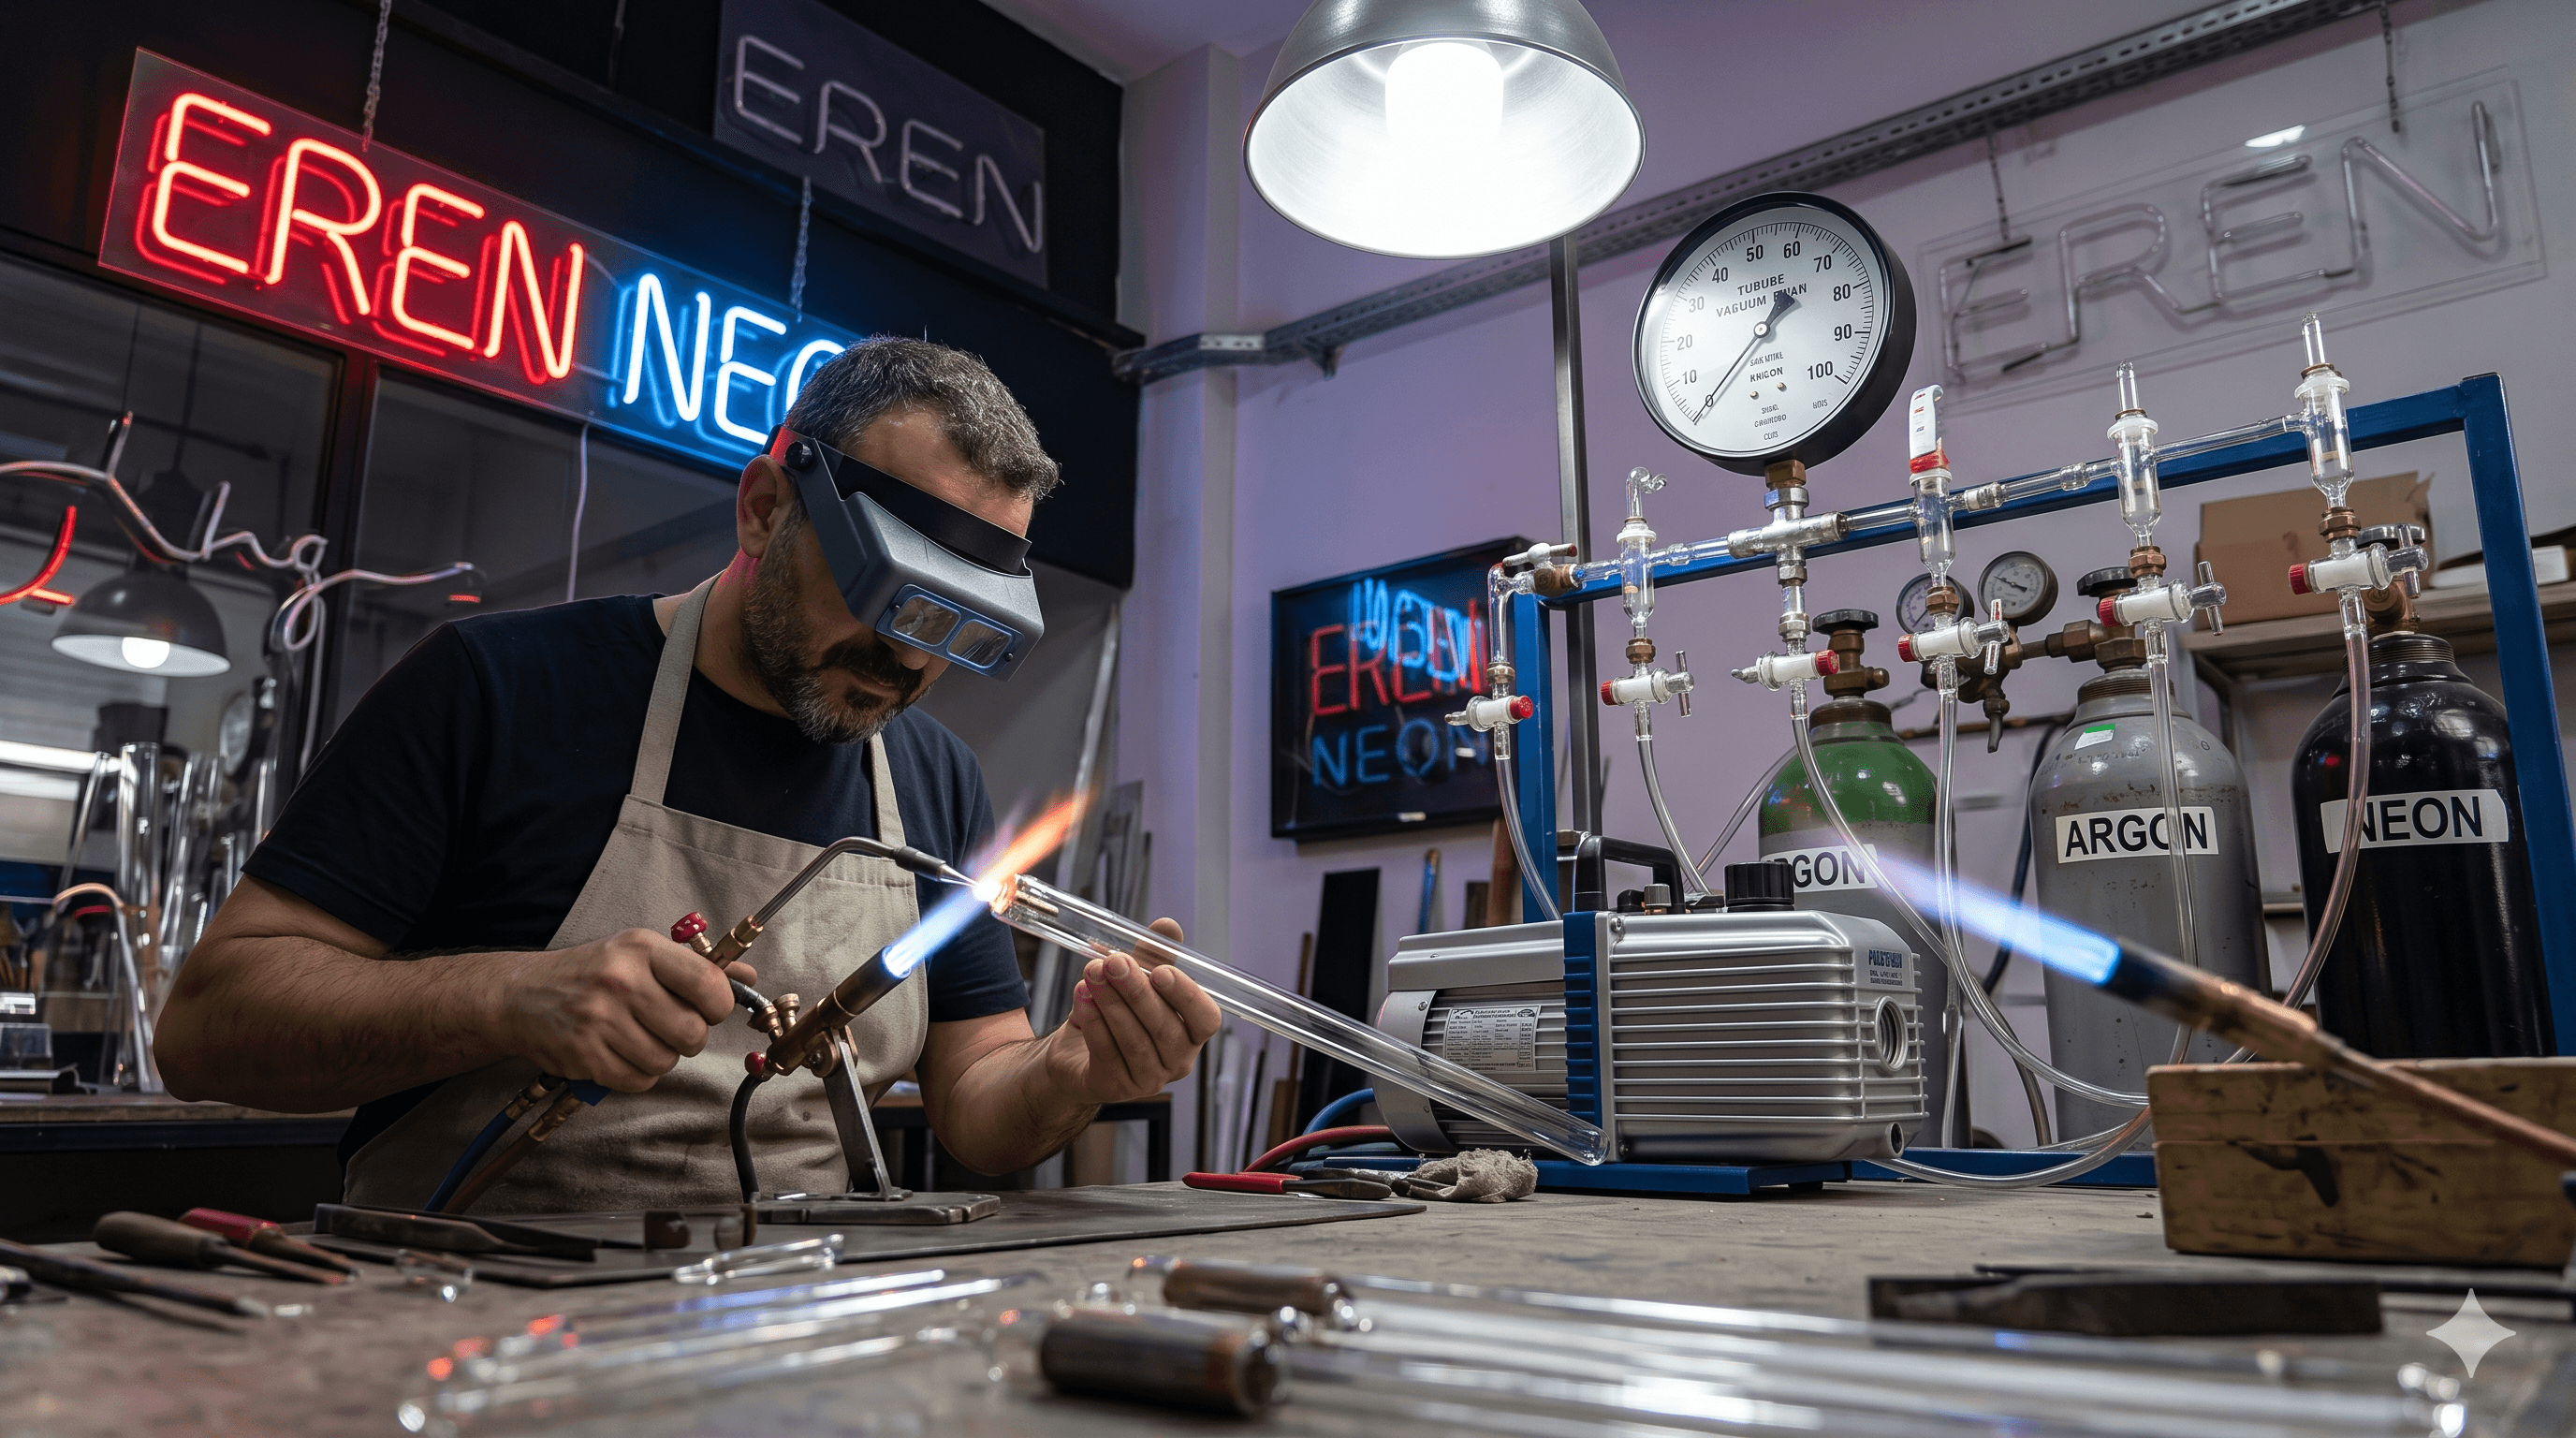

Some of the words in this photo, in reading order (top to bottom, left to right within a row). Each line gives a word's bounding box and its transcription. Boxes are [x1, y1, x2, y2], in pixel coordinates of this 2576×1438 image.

[734, 34, 1042, 254] EREN
[152, 92, 585, 380] EREN
[1939, 100, 2497, 374] EREN
[1746, 244, 1764, 262] 50
[1783, 241, 1801, 258] 60
[1813, 254, 1832, 272] 70
[1712, 267, 1729, 283] 40
[1737, 273, 1785, 296] TUBUBE
[1833, 283, 1851, 301] 80
[1689, 296, 1705, 313] 30
[1834, 323, 1852, 341] 90
[1676, 334, 1693, 351] 20
[1682, 369, 1697, 385] 10
[1807, 360, 1834, 380] 100
[2065, 813, 2208, 858] ARGON
[1766, 850, 1866, 888] GON
